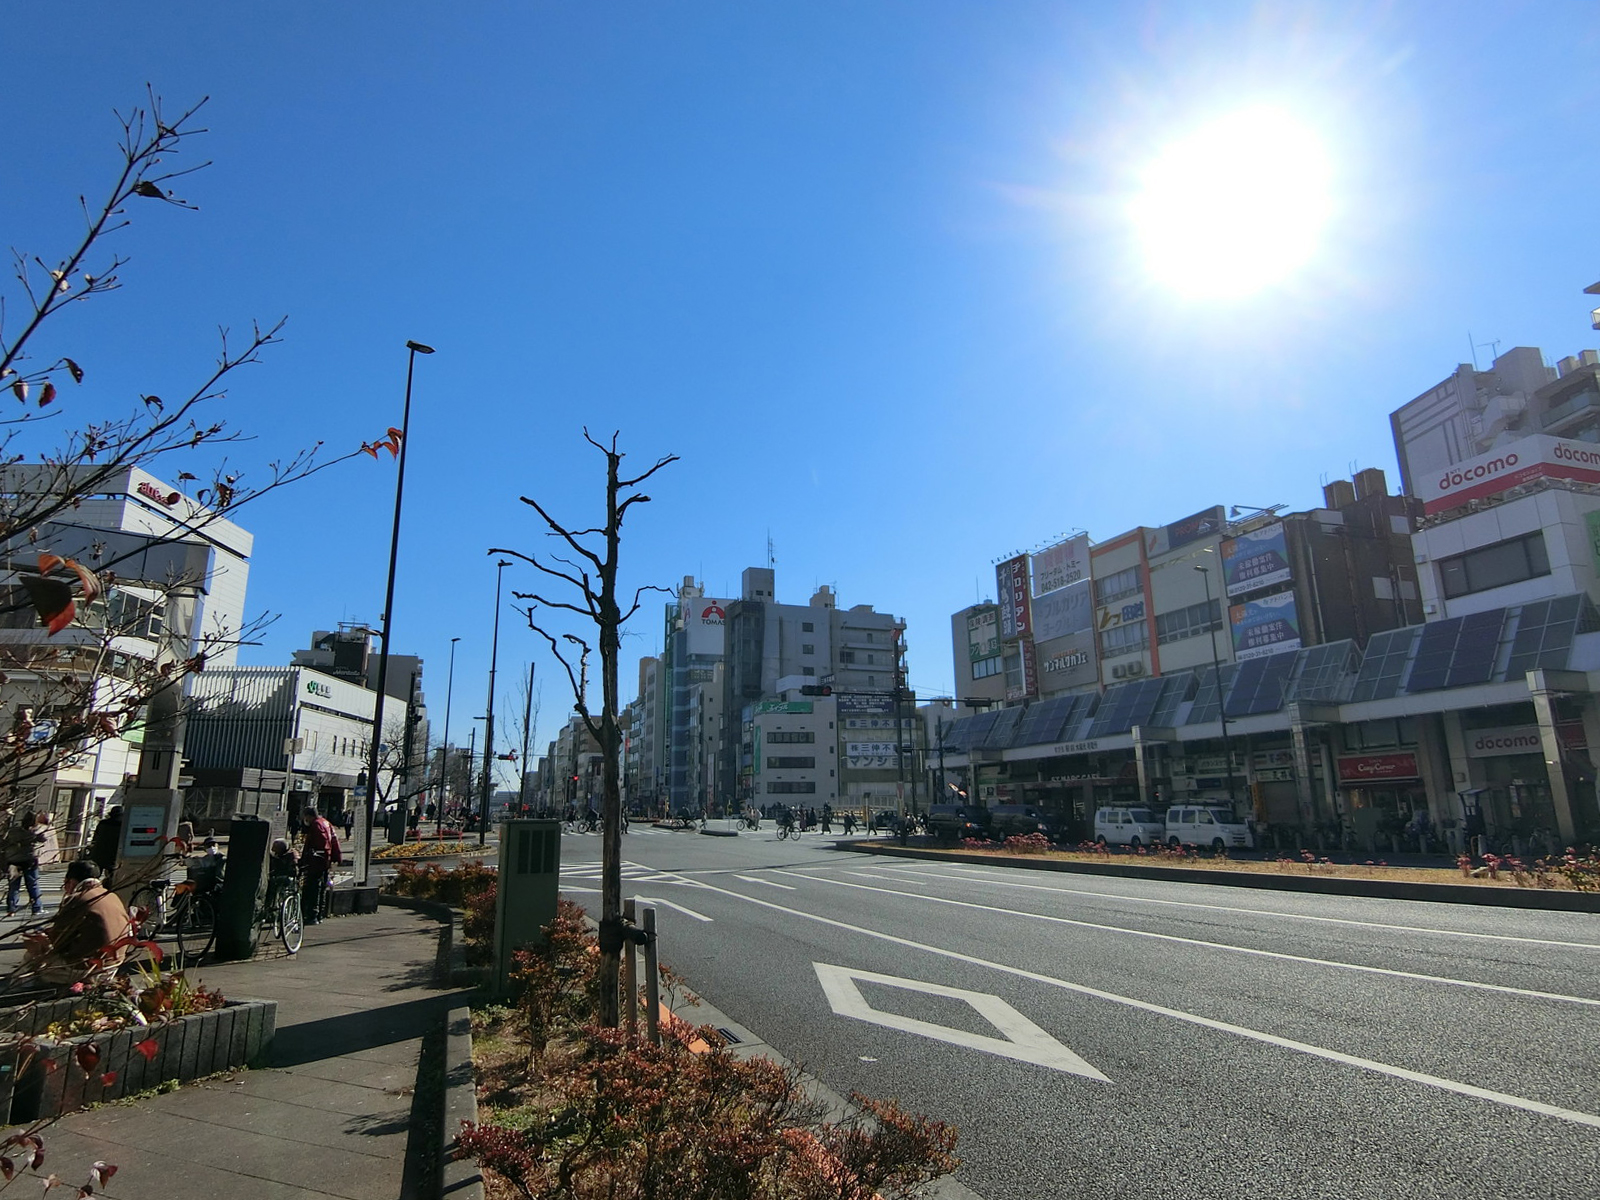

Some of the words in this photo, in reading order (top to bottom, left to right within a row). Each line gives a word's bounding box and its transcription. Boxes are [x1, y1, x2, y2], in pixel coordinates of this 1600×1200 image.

[1554, 443, 1600, 464] docom
[1439, 453, 1519, 490] docomo
[1011, 561, 1026, 632] チロリアン
[702, 618, 726, 626] TOMAS
[1475, 735, 1539, 750] docomo
[850, 756, 900, 767] マンショ
